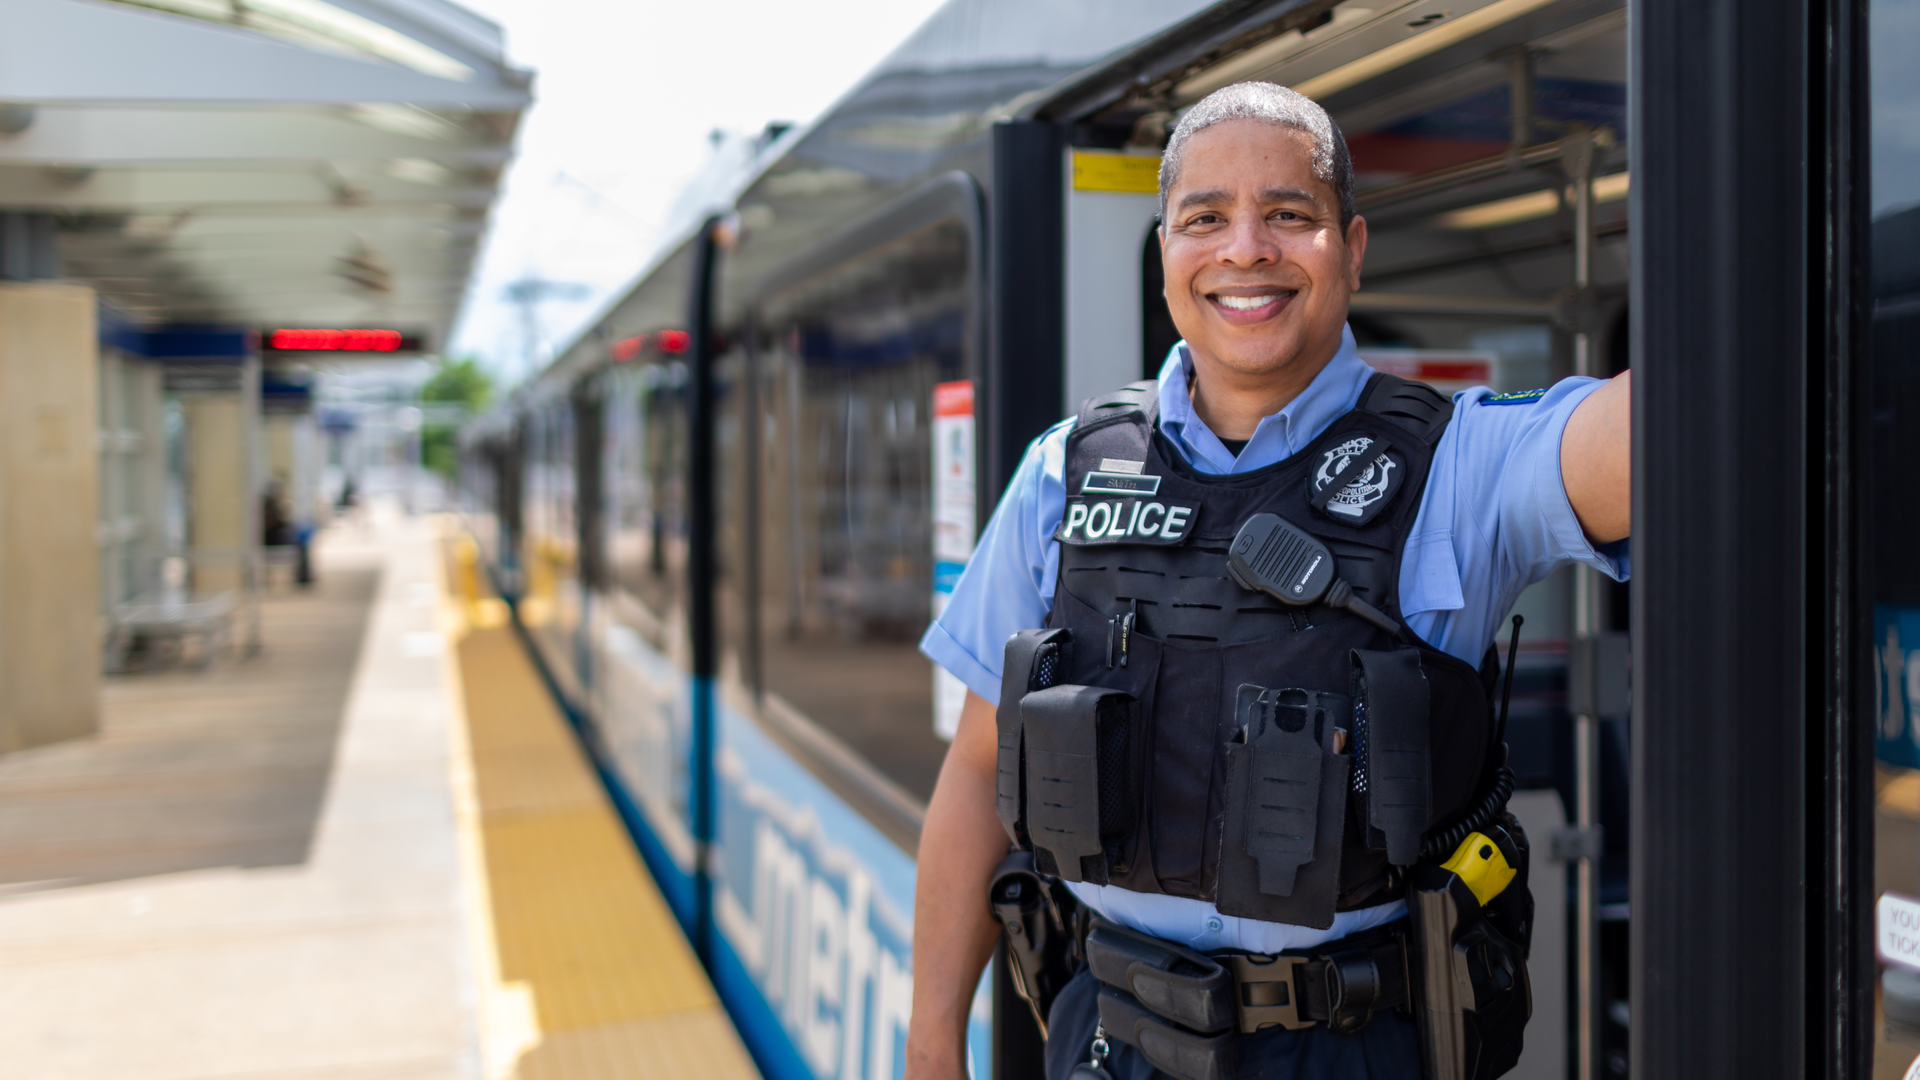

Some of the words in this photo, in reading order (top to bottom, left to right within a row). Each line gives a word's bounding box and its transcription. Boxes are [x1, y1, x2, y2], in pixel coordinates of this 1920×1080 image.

[1107, 478, 1137, 489] SMITH
[1332, 493, 1365, 505] OLICE
[1063, 501, 1192, 538] POLICE
[1301, 555, 1322, 585] MOTOROLA
